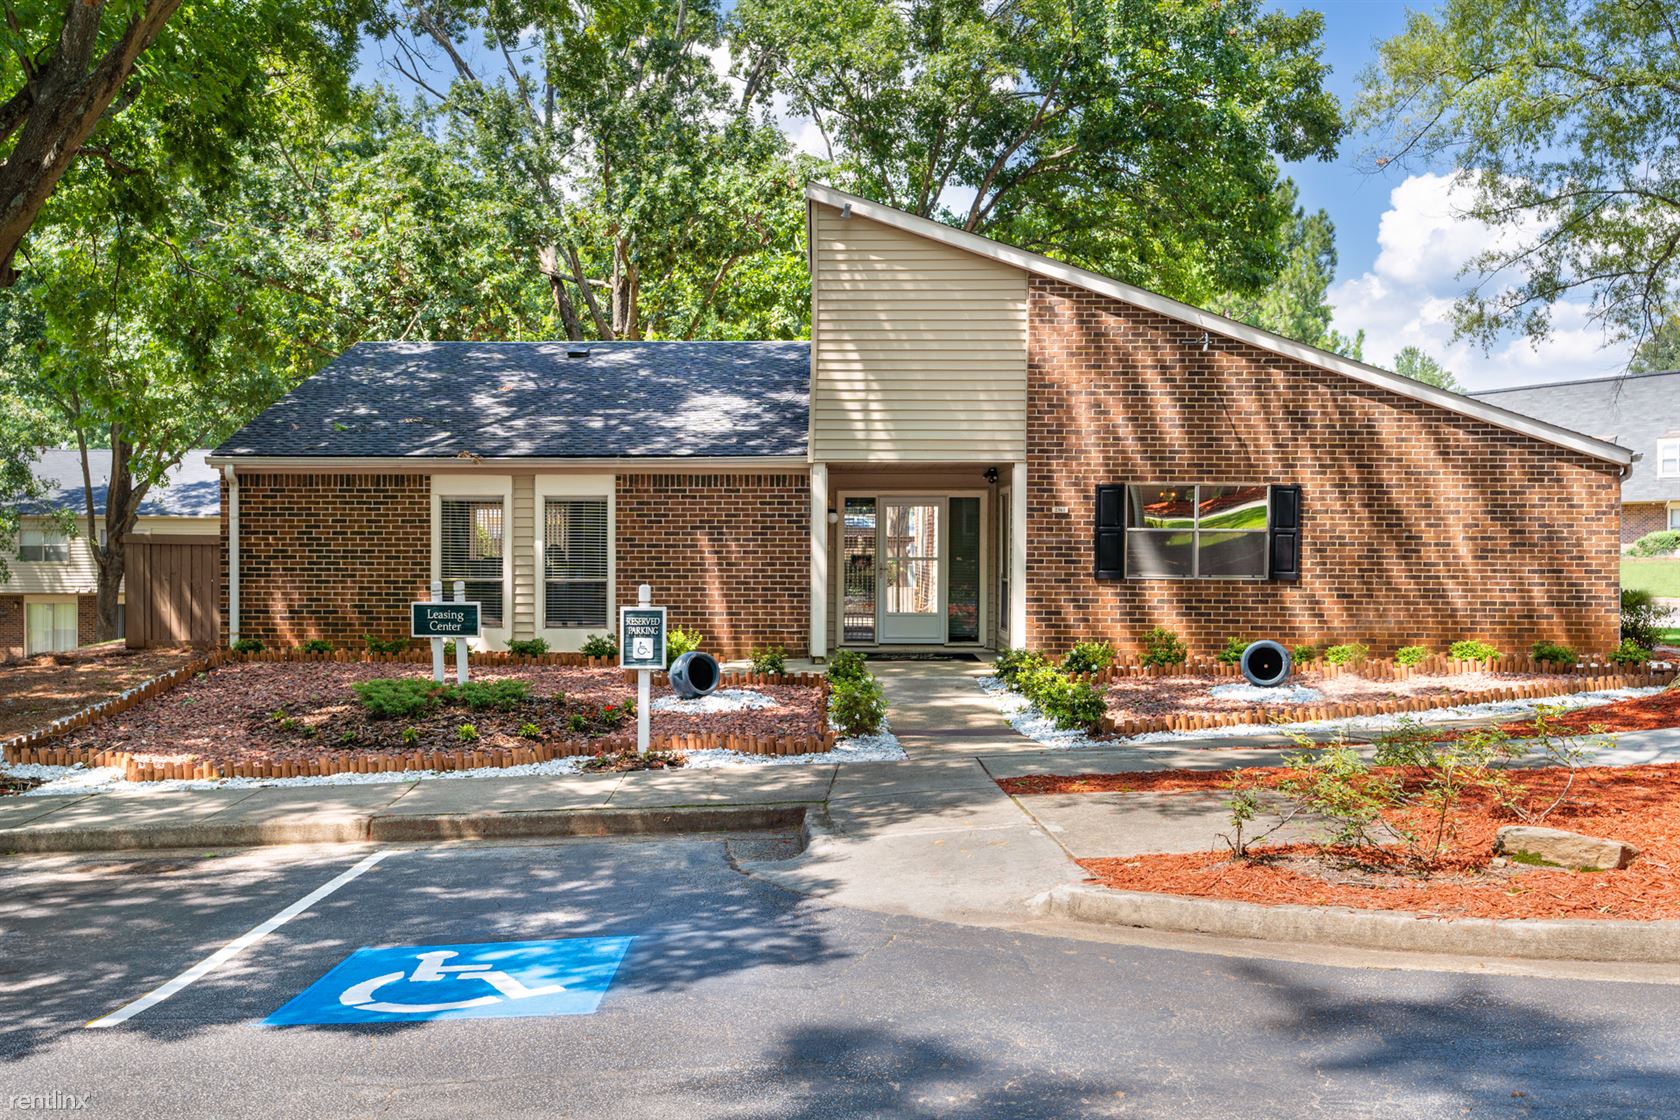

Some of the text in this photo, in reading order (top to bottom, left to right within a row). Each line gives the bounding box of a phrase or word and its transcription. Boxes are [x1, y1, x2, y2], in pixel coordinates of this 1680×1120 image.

[427, 608, 464, 622] Leasing
[429, 620, 462, 631] Center
[625, 617, 660, 626] RESERVED
[628, 626, 659, 635] PARKING
